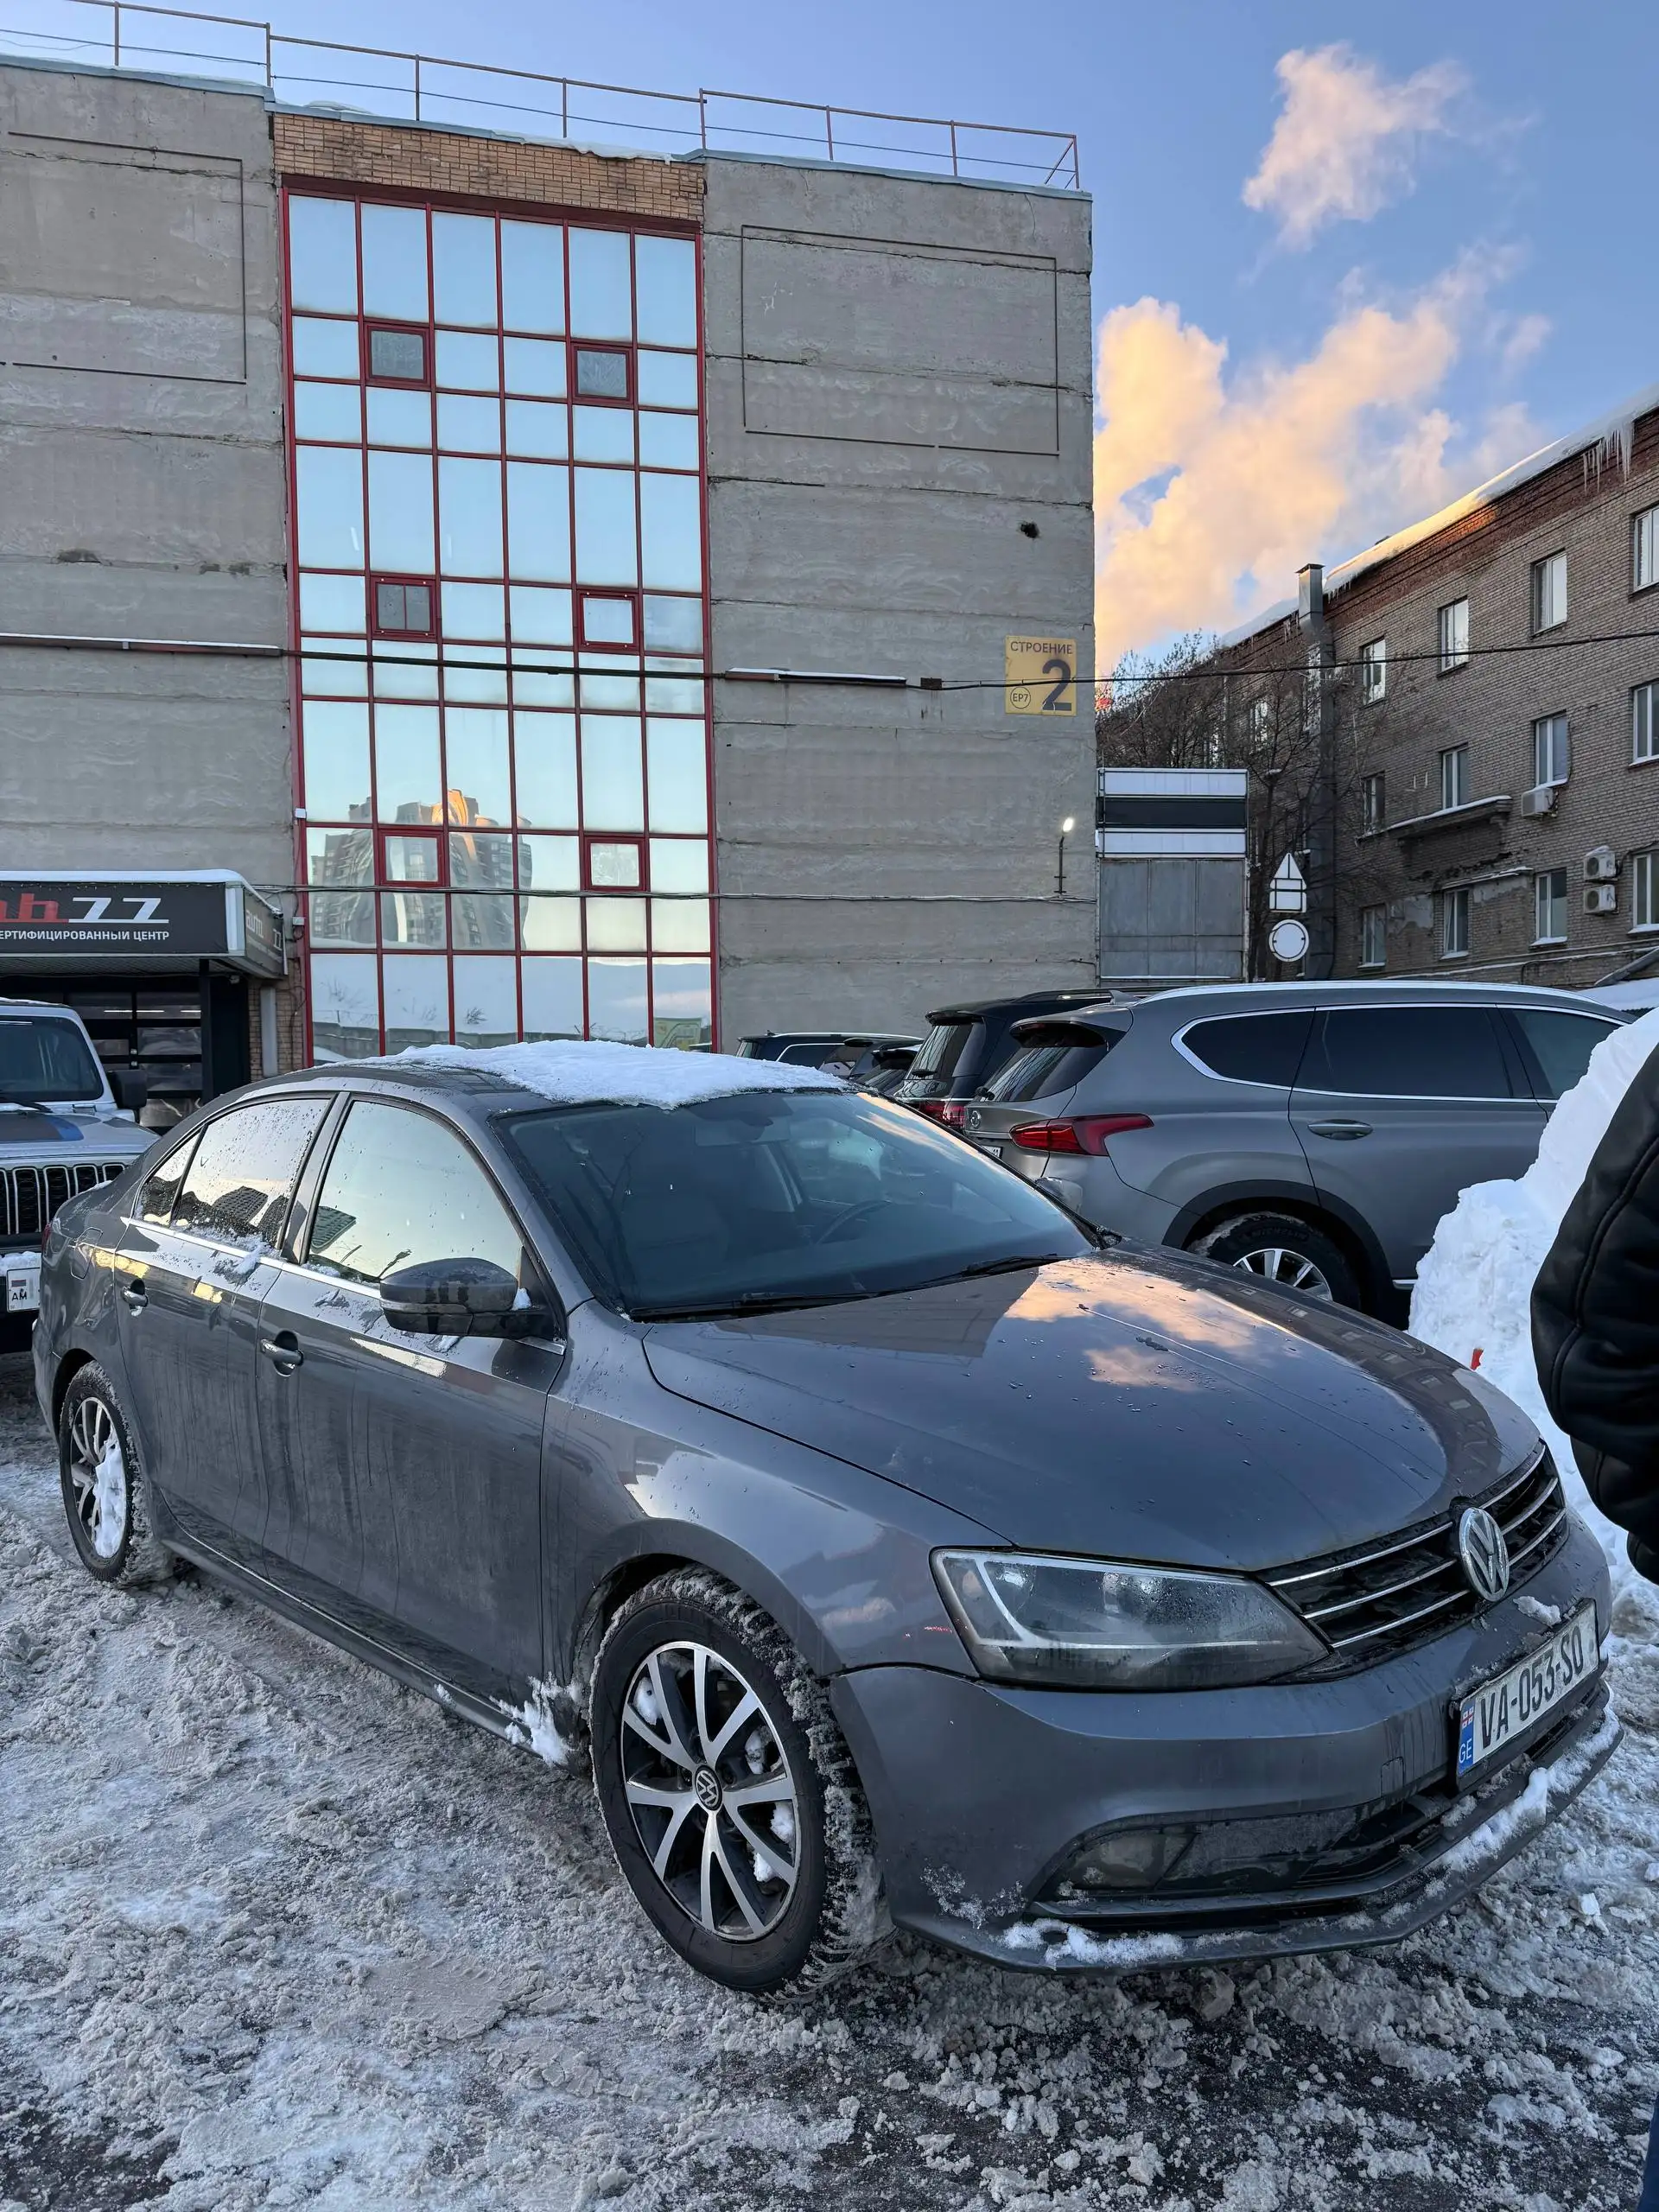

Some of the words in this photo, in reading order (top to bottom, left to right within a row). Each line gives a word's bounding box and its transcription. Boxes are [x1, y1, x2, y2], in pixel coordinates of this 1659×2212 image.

[1010, 641, 1073, 654] СТРОЕНИЕ
[1042, 658, 1071, 711] 2
[133, 931, 169, 942] ЦЕНТР
[11, 1291, 28, 1301] AM
[1459, 1738, 1472, 1764] GE
